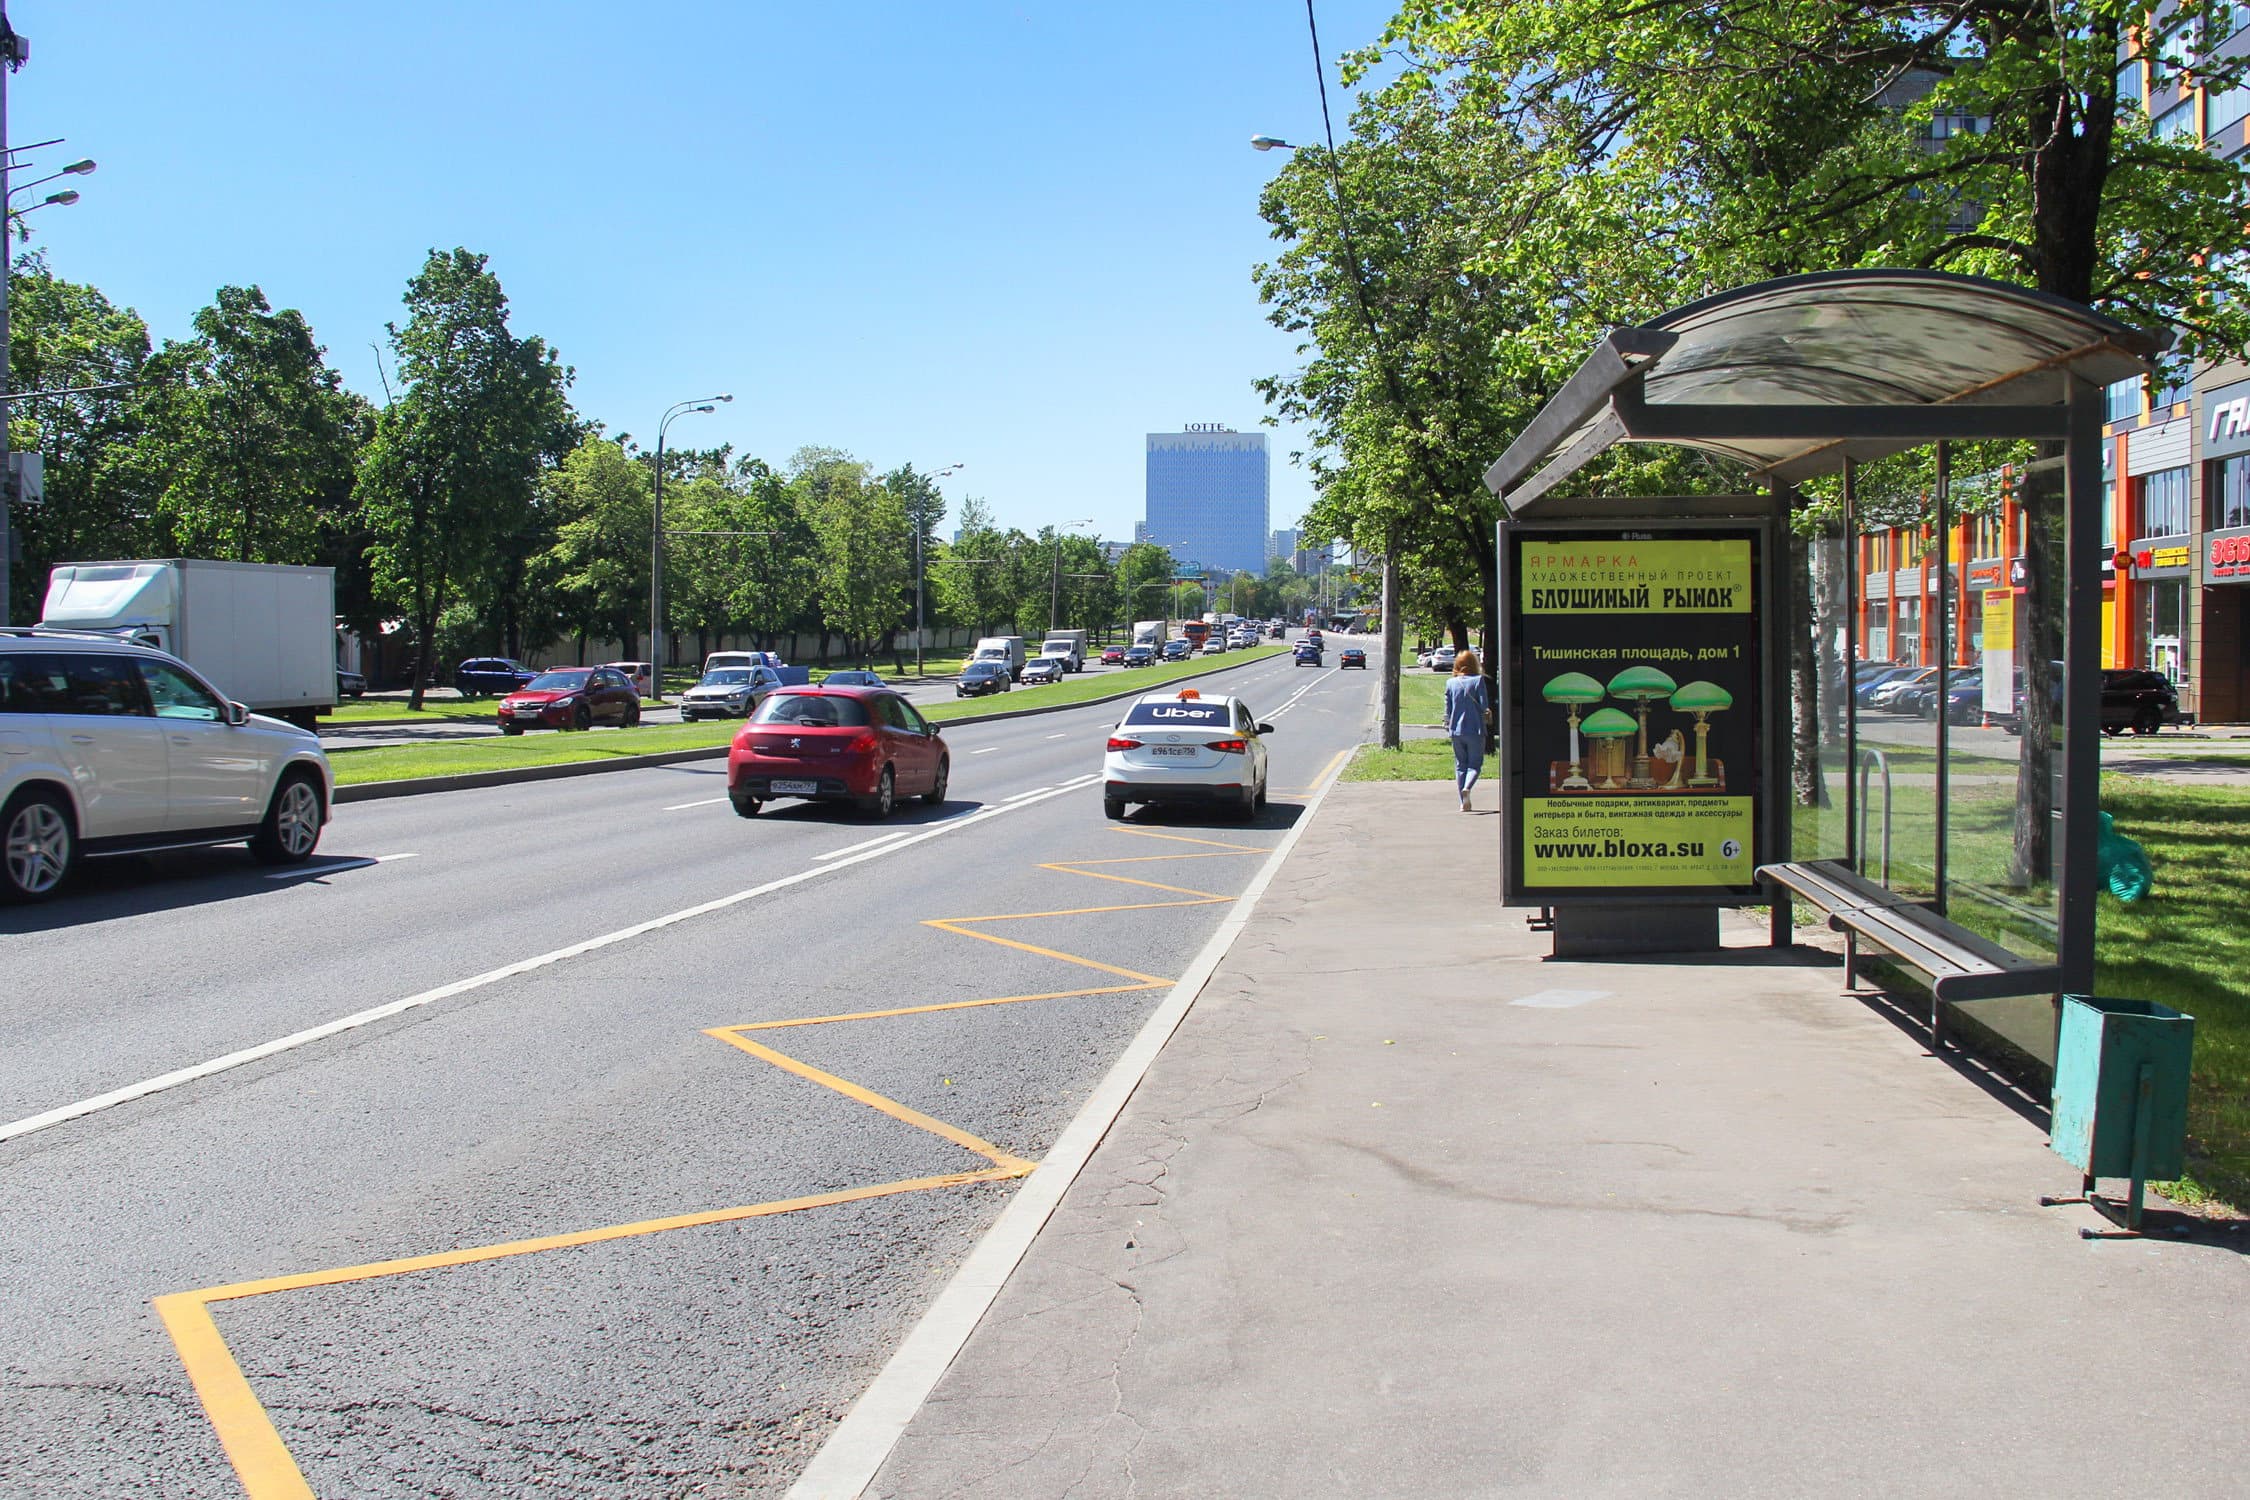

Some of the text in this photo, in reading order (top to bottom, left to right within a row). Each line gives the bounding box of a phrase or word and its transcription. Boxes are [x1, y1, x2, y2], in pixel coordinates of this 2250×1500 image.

[1184, 423, 1224, 432] LOTTE
[1530, 556, 1639, 568] ЯРМАРКА
[1531, 570, 1733, 582] ХУДОЖЕСТВЕННЫЙ ПРОЕКТ
[1531, 583, 1650, 609] БЛОШИНЫЙ
[1532, 646, 1740, 661] Тишинская площадь, дом 1
[1152, 708, 1215, 718] Uber
[1547, 799, 1729, 808] Необычные подарки, антиквариат, предметы
[1533, 811, 1575, 819] интерьера
[1584, 810, 1607, 819] быта,
[1695, 810, 1743, 818] аксессуары
[1534, 825, 1624, 838] Заказ билетов:
[1534, 840, 1704, 859] www.bloxa.su
[1722, 841, 1740, 857] 6+
